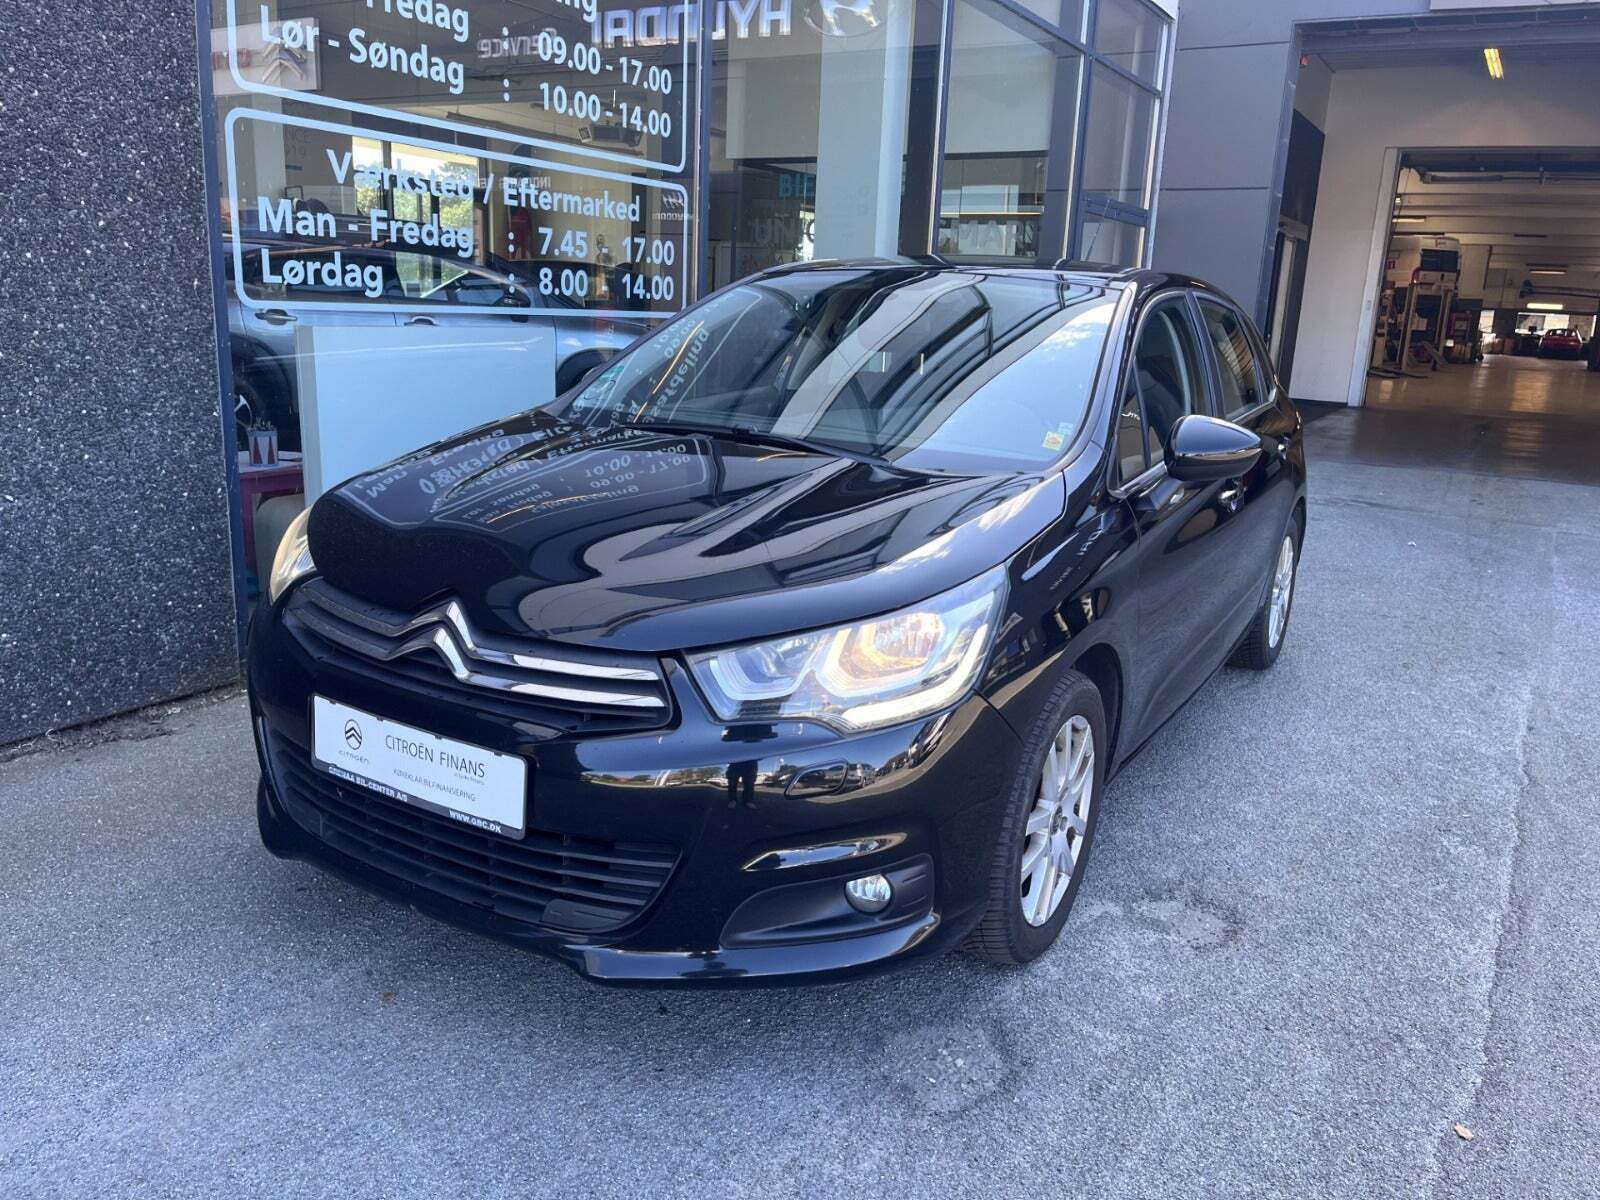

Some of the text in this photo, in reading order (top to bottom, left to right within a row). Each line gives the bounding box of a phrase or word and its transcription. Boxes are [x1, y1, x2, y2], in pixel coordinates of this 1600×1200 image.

[260, 5, 319, 52] Lør
[349, 27, 464, 95] Søndag
[539, 82, 601, 122] 10.00
[619, 102, 672, 137] 14.00
[366, 0, 469, 42] edag
[538, 31, 601, 75] 09.00
[619, 57, 672, 95] 17.00
[326, 148, 475, 199] Værksted
[503, 176, 640, 222] Eftermarked
[257, 196, 337, 238] Man
[370, 208, 474, 258] Fredag
[538, 226, 588, 258] 7.45
[622, 236, 675, 265] 17.00
[261, 248, 384, 298] Lørdag
[539, 267, 588, 297] 8.00
[622, 273, 674, 300] 14.00
[385, 734, 486, 778] CITROËN FINANS
